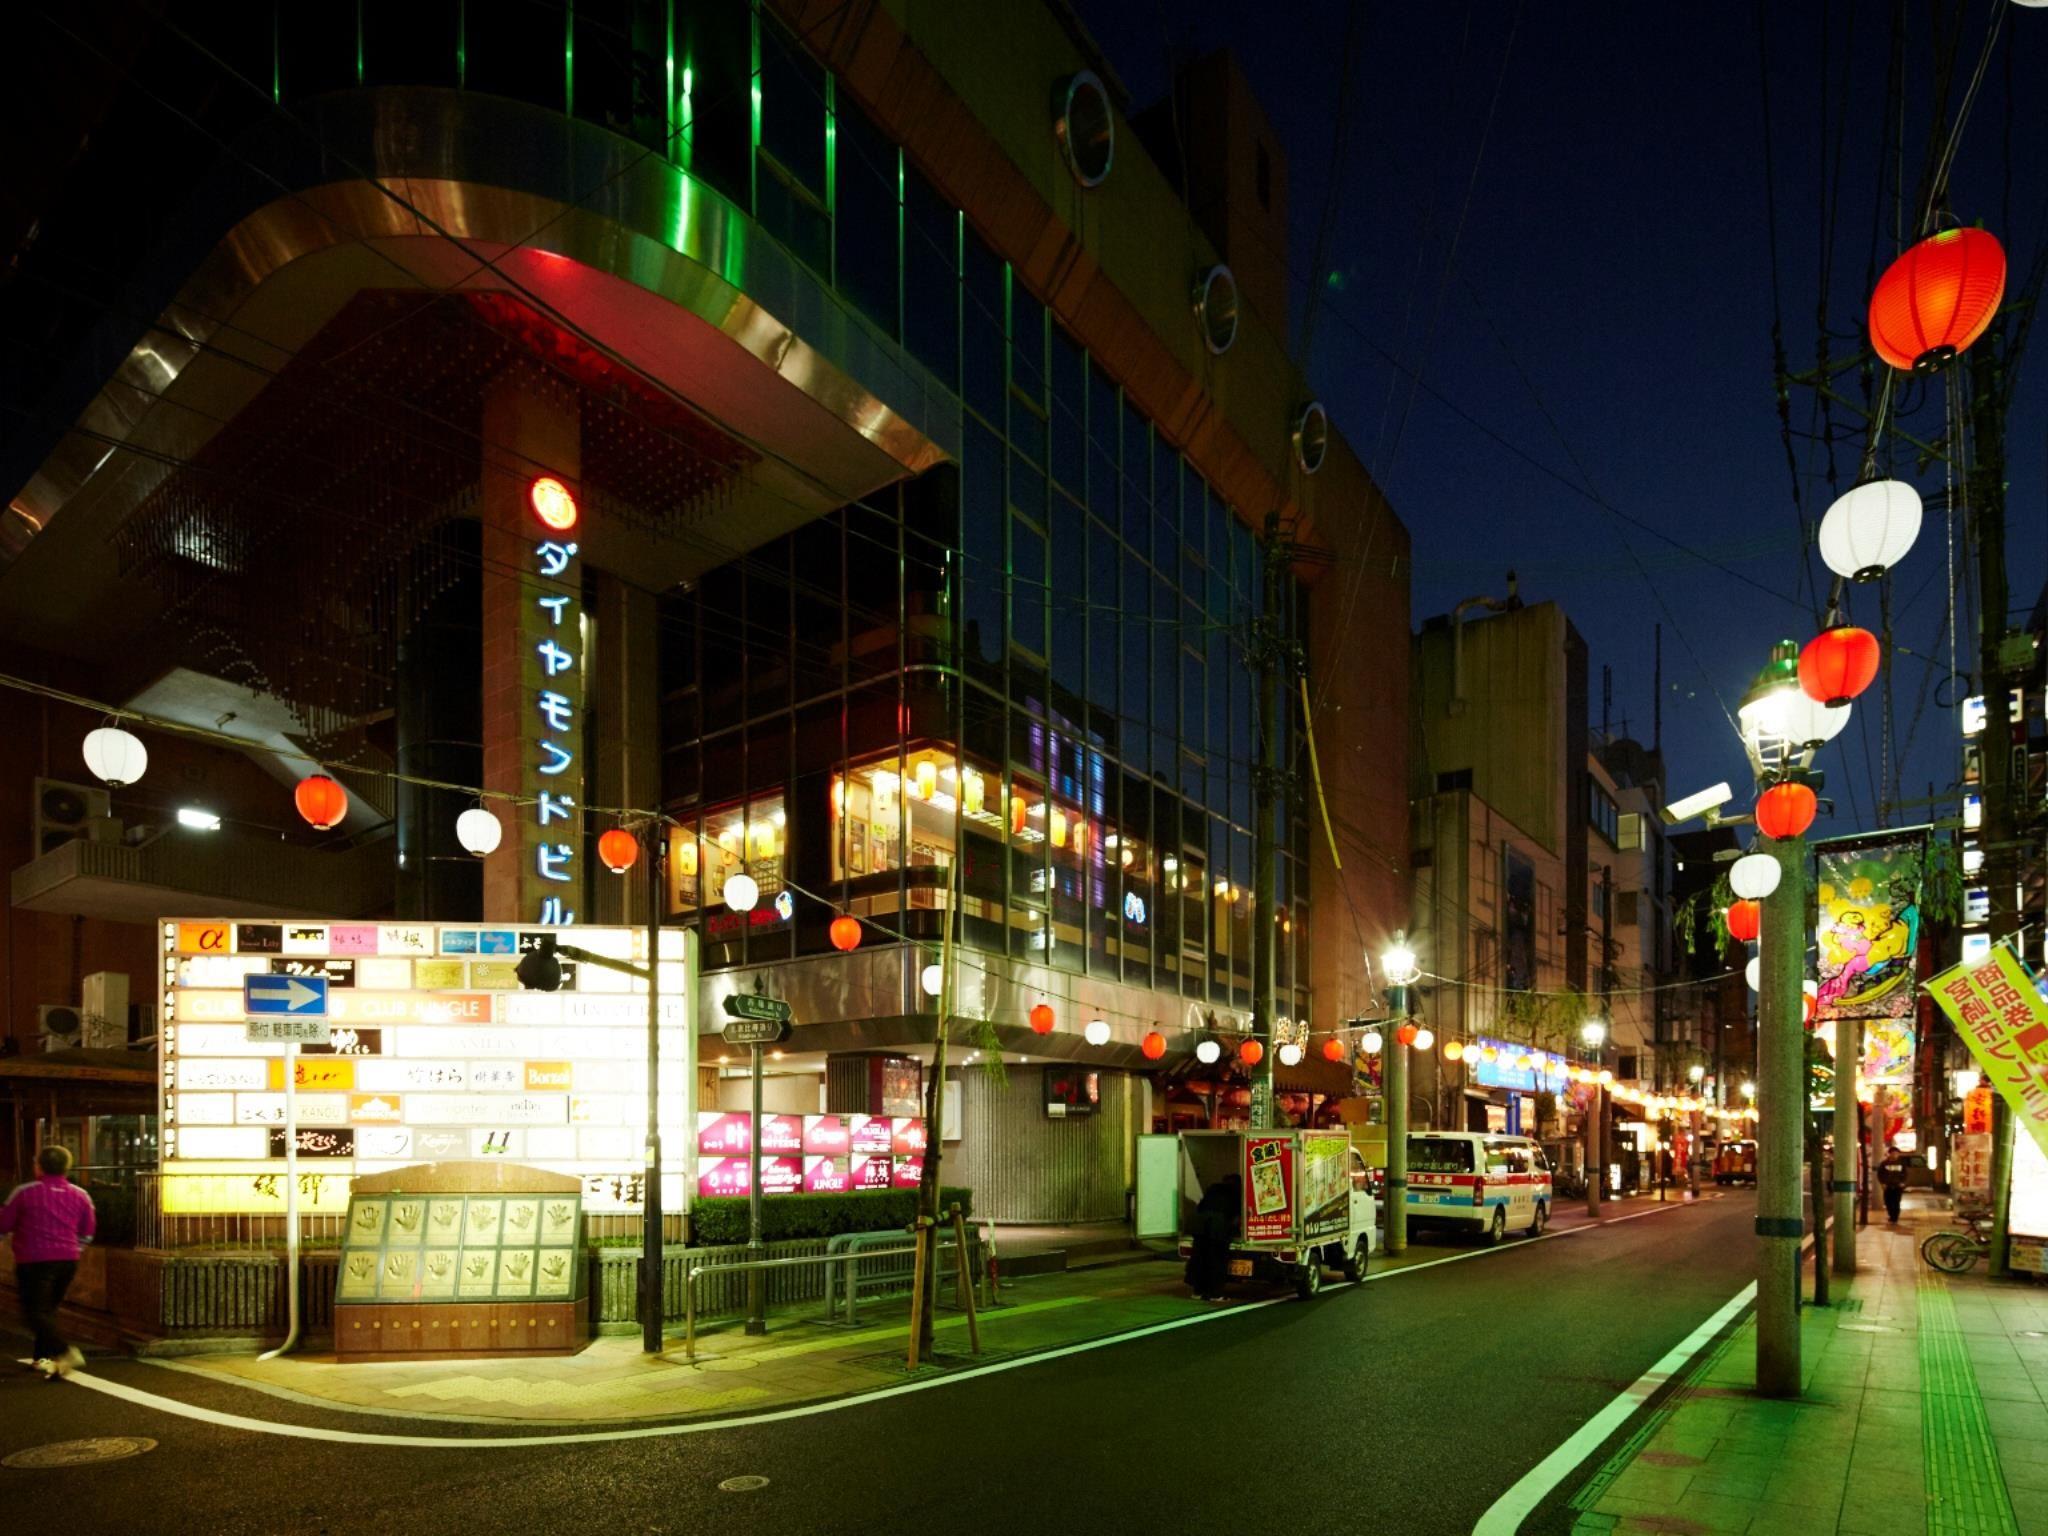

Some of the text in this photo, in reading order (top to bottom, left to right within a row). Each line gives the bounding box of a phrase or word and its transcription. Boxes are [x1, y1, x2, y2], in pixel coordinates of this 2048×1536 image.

[535, 540, 579, 926] ダイヤモンドビル
[249, 1022, 269, 1037] 原付
